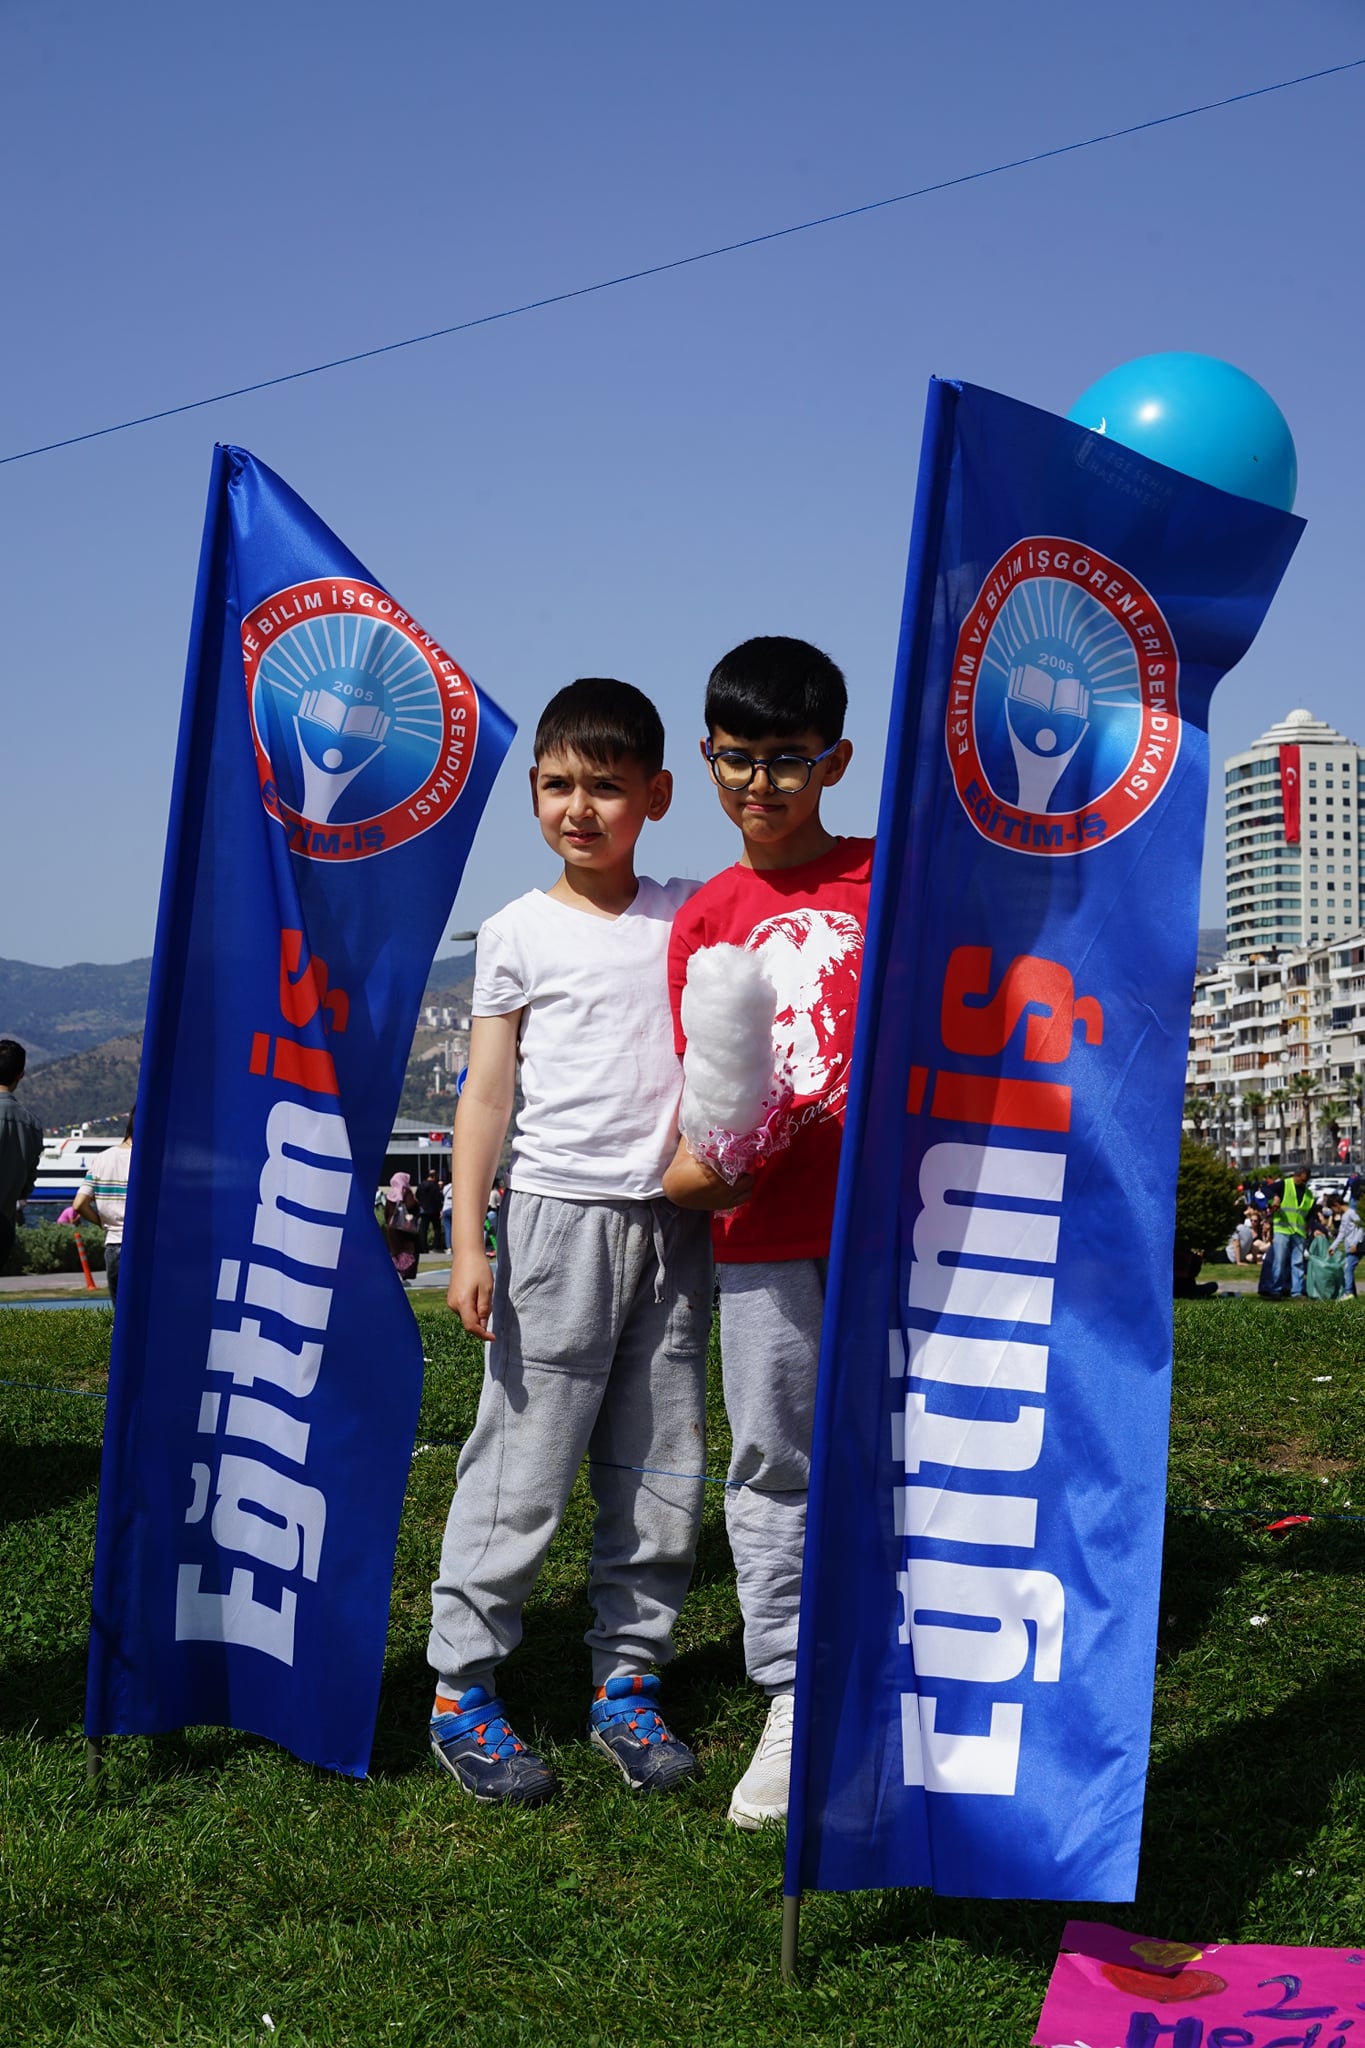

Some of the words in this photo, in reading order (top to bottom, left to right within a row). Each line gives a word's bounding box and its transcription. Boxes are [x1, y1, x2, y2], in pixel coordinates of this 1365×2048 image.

[332, 680, 375, 702] 2005
[950, 655, 977, 756] EĞİTİM
[969, 611, 989, 645] VE
[986, 555, 1023, 612] BİLİM
[1028, 546, 1169, 658] İŞGÖRENLERİ
[1123, 663, 1172, 801] SENDİKASI
[1037, 651, 1075, 675] 2005
[257, 590, 323, 636] BİLİM
[331, 585, 469, 698] İŞGÖRENLERİ
[408, 707, 467, 822] SENDİKASI
[261, 778, 386, 854] ETİM-İŞ
[963, 778, 1108, 847] EĞİTİM-İŞ
[1241, 1974, 1339, 2021] 2
